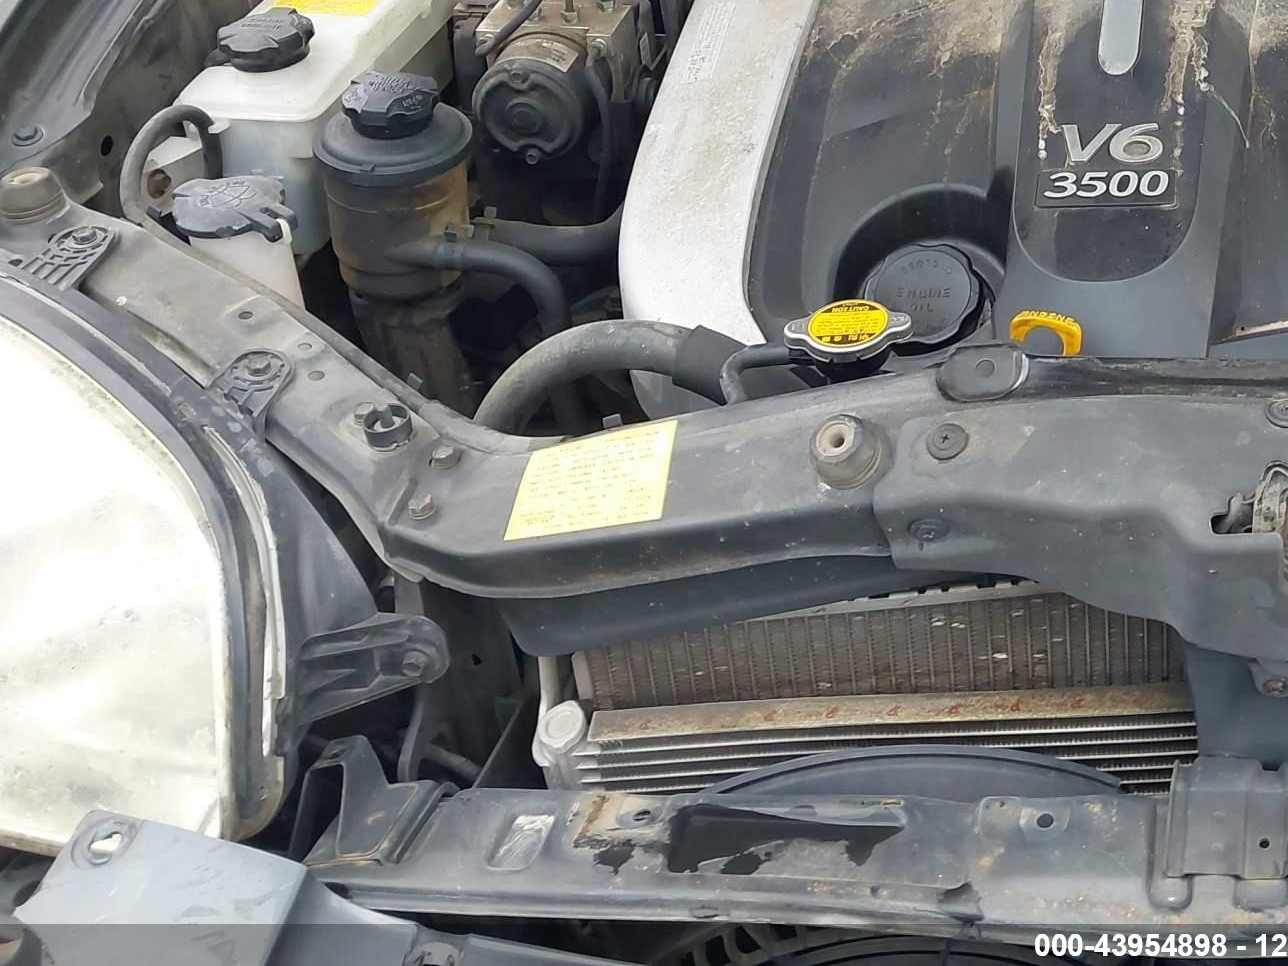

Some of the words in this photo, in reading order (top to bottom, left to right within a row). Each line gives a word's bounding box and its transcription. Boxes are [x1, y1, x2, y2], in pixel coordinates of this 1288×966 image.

[1062, 123, 1163, 163] V6
[1043, 170, 1169, 198] 3500
[897, 287, 951, 299] ENGINE
